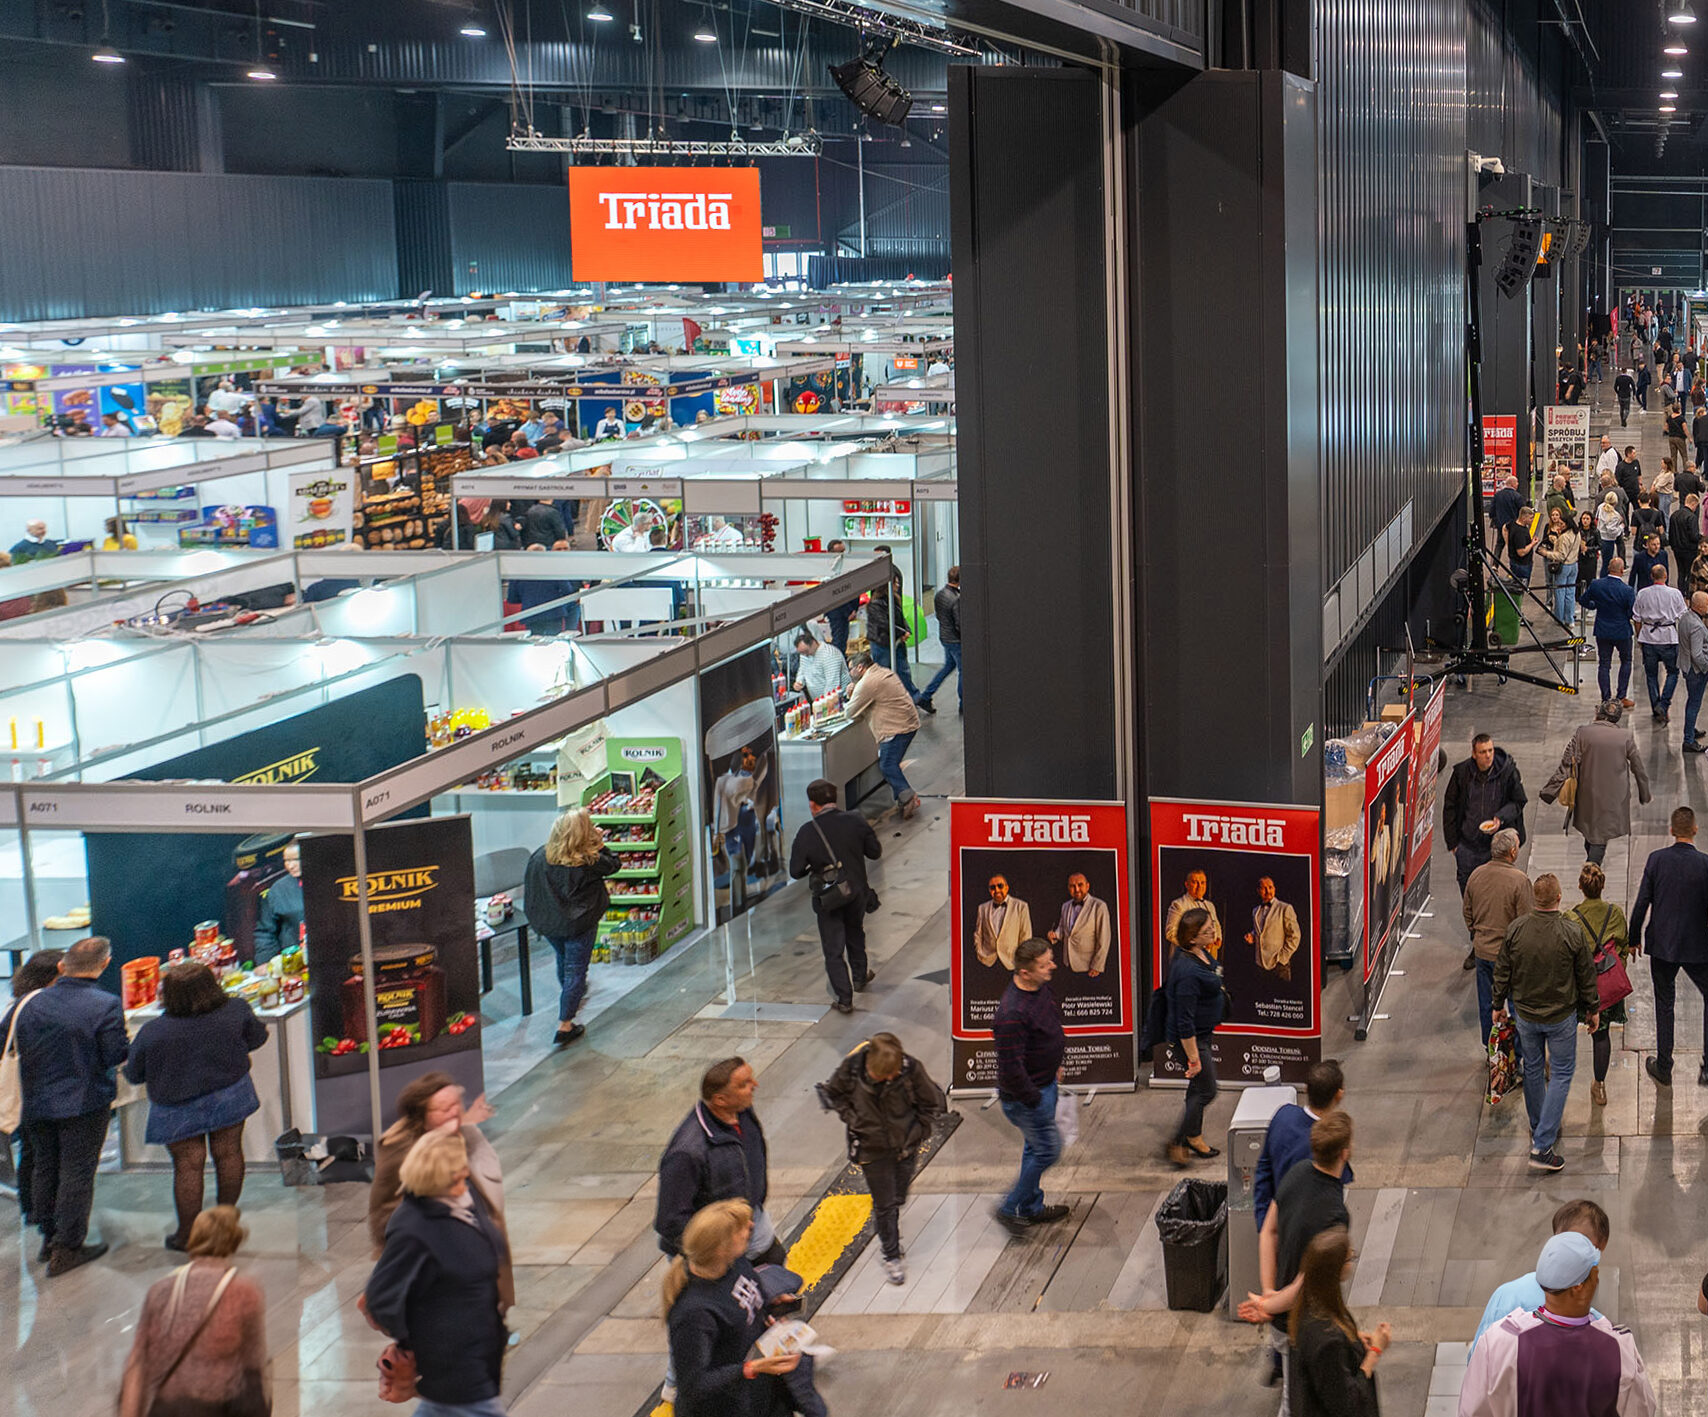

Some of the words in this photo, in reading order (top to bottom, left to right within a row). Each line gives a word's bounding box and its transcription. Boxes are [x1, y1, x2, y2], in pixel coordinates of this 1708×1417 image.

[599, 192, 732, 230] Triada
[1483, 427, 1514, 438] riada
[1548, 429, 1586, 437] SPRÓBUJ
[492, 730, 525, 751] ROLNIK
[236, 750, 318, 784] OLNIK
[559, 771, 583, 781] ROLNI
[365, 791, 391, 809] A071
[30, 803, 58, 813] A071
[185, 803, 232, 815] ROLNIK
[984, 814, 1090, 842] Triada
[1183, 814, 1286, 847] Triada
[341, 869, 437, 899] ROLNIK
[368, 899, 421, 914] REMIUM
[1061, 1002, 1076, 1010] Piotr
[1255, 1002, 1282, 1011] Sebastian
[1282, 1004, 1304, 1012] Stencel
